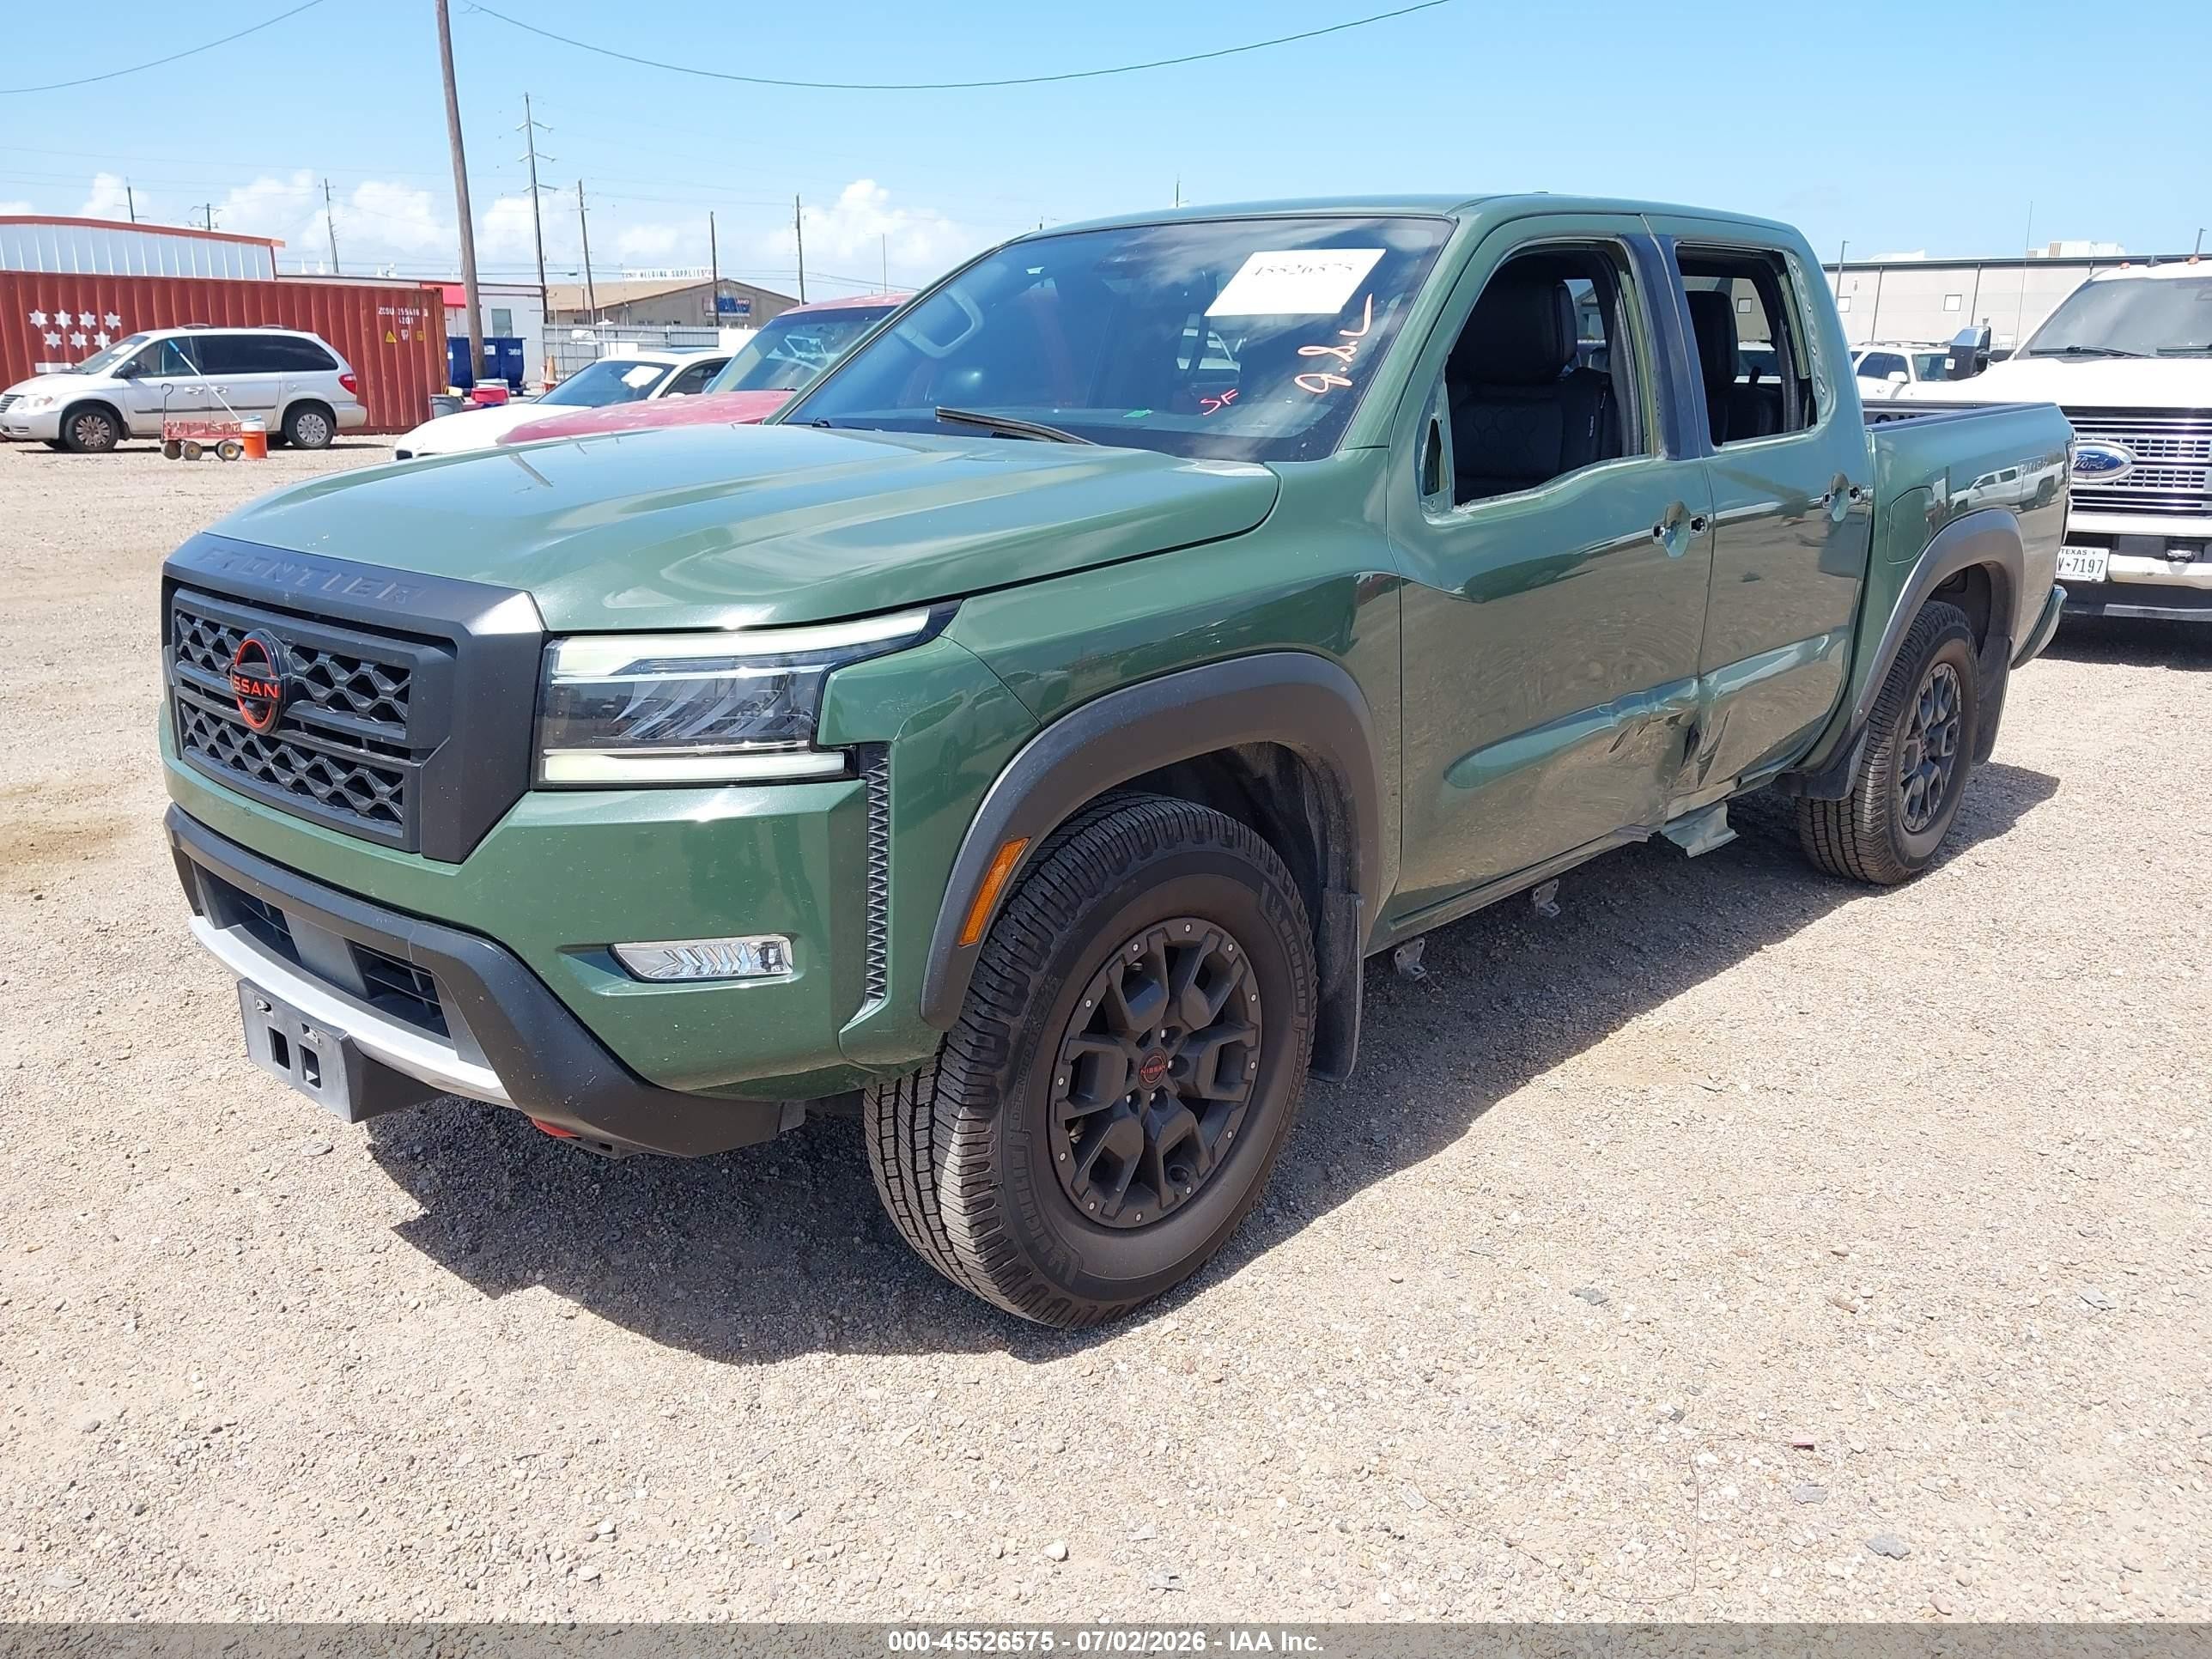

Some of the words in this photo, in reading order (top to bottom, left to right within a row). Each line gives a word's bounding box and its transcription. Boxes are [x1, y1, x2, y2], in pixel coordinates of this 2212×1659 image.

[2060, 548, 2087, 556] TEXAS
[197, 547, 427, 606] FRONTIER
[233, 675, 279, 699] SSAN
[1279, 918, 1306, 1013] MICHELIN
